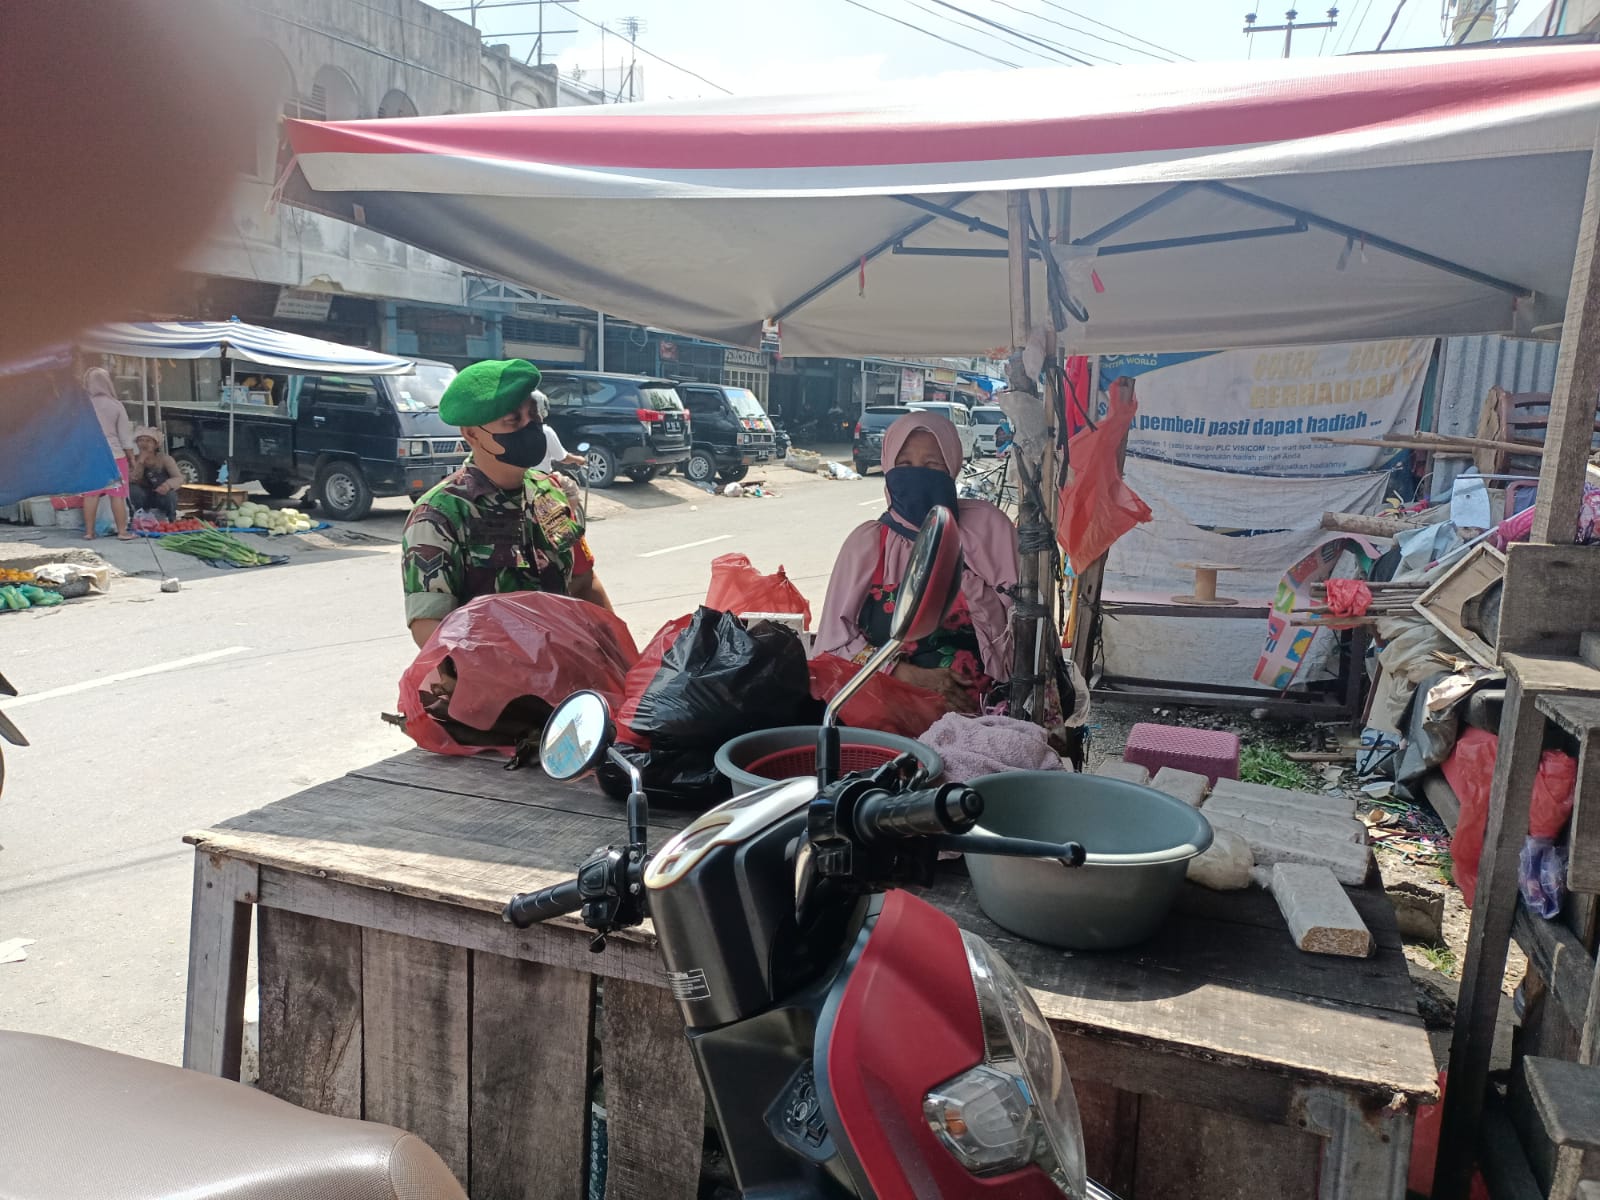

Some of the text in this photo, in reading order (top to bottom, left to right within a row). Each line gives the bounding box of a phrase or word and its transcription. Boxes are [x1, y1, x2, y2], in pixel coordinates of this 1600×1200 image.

[1127, 357, 1157, 366] WORLD
[1140, 414, 1206, 434] pembeli
[1208, 418, 1250, 437] pasti
[1252, 418, 1303, 437] dapat
[1306, 411, 1368, 433] hadiah
[1232, 444, 1265, 452] VISICOM
